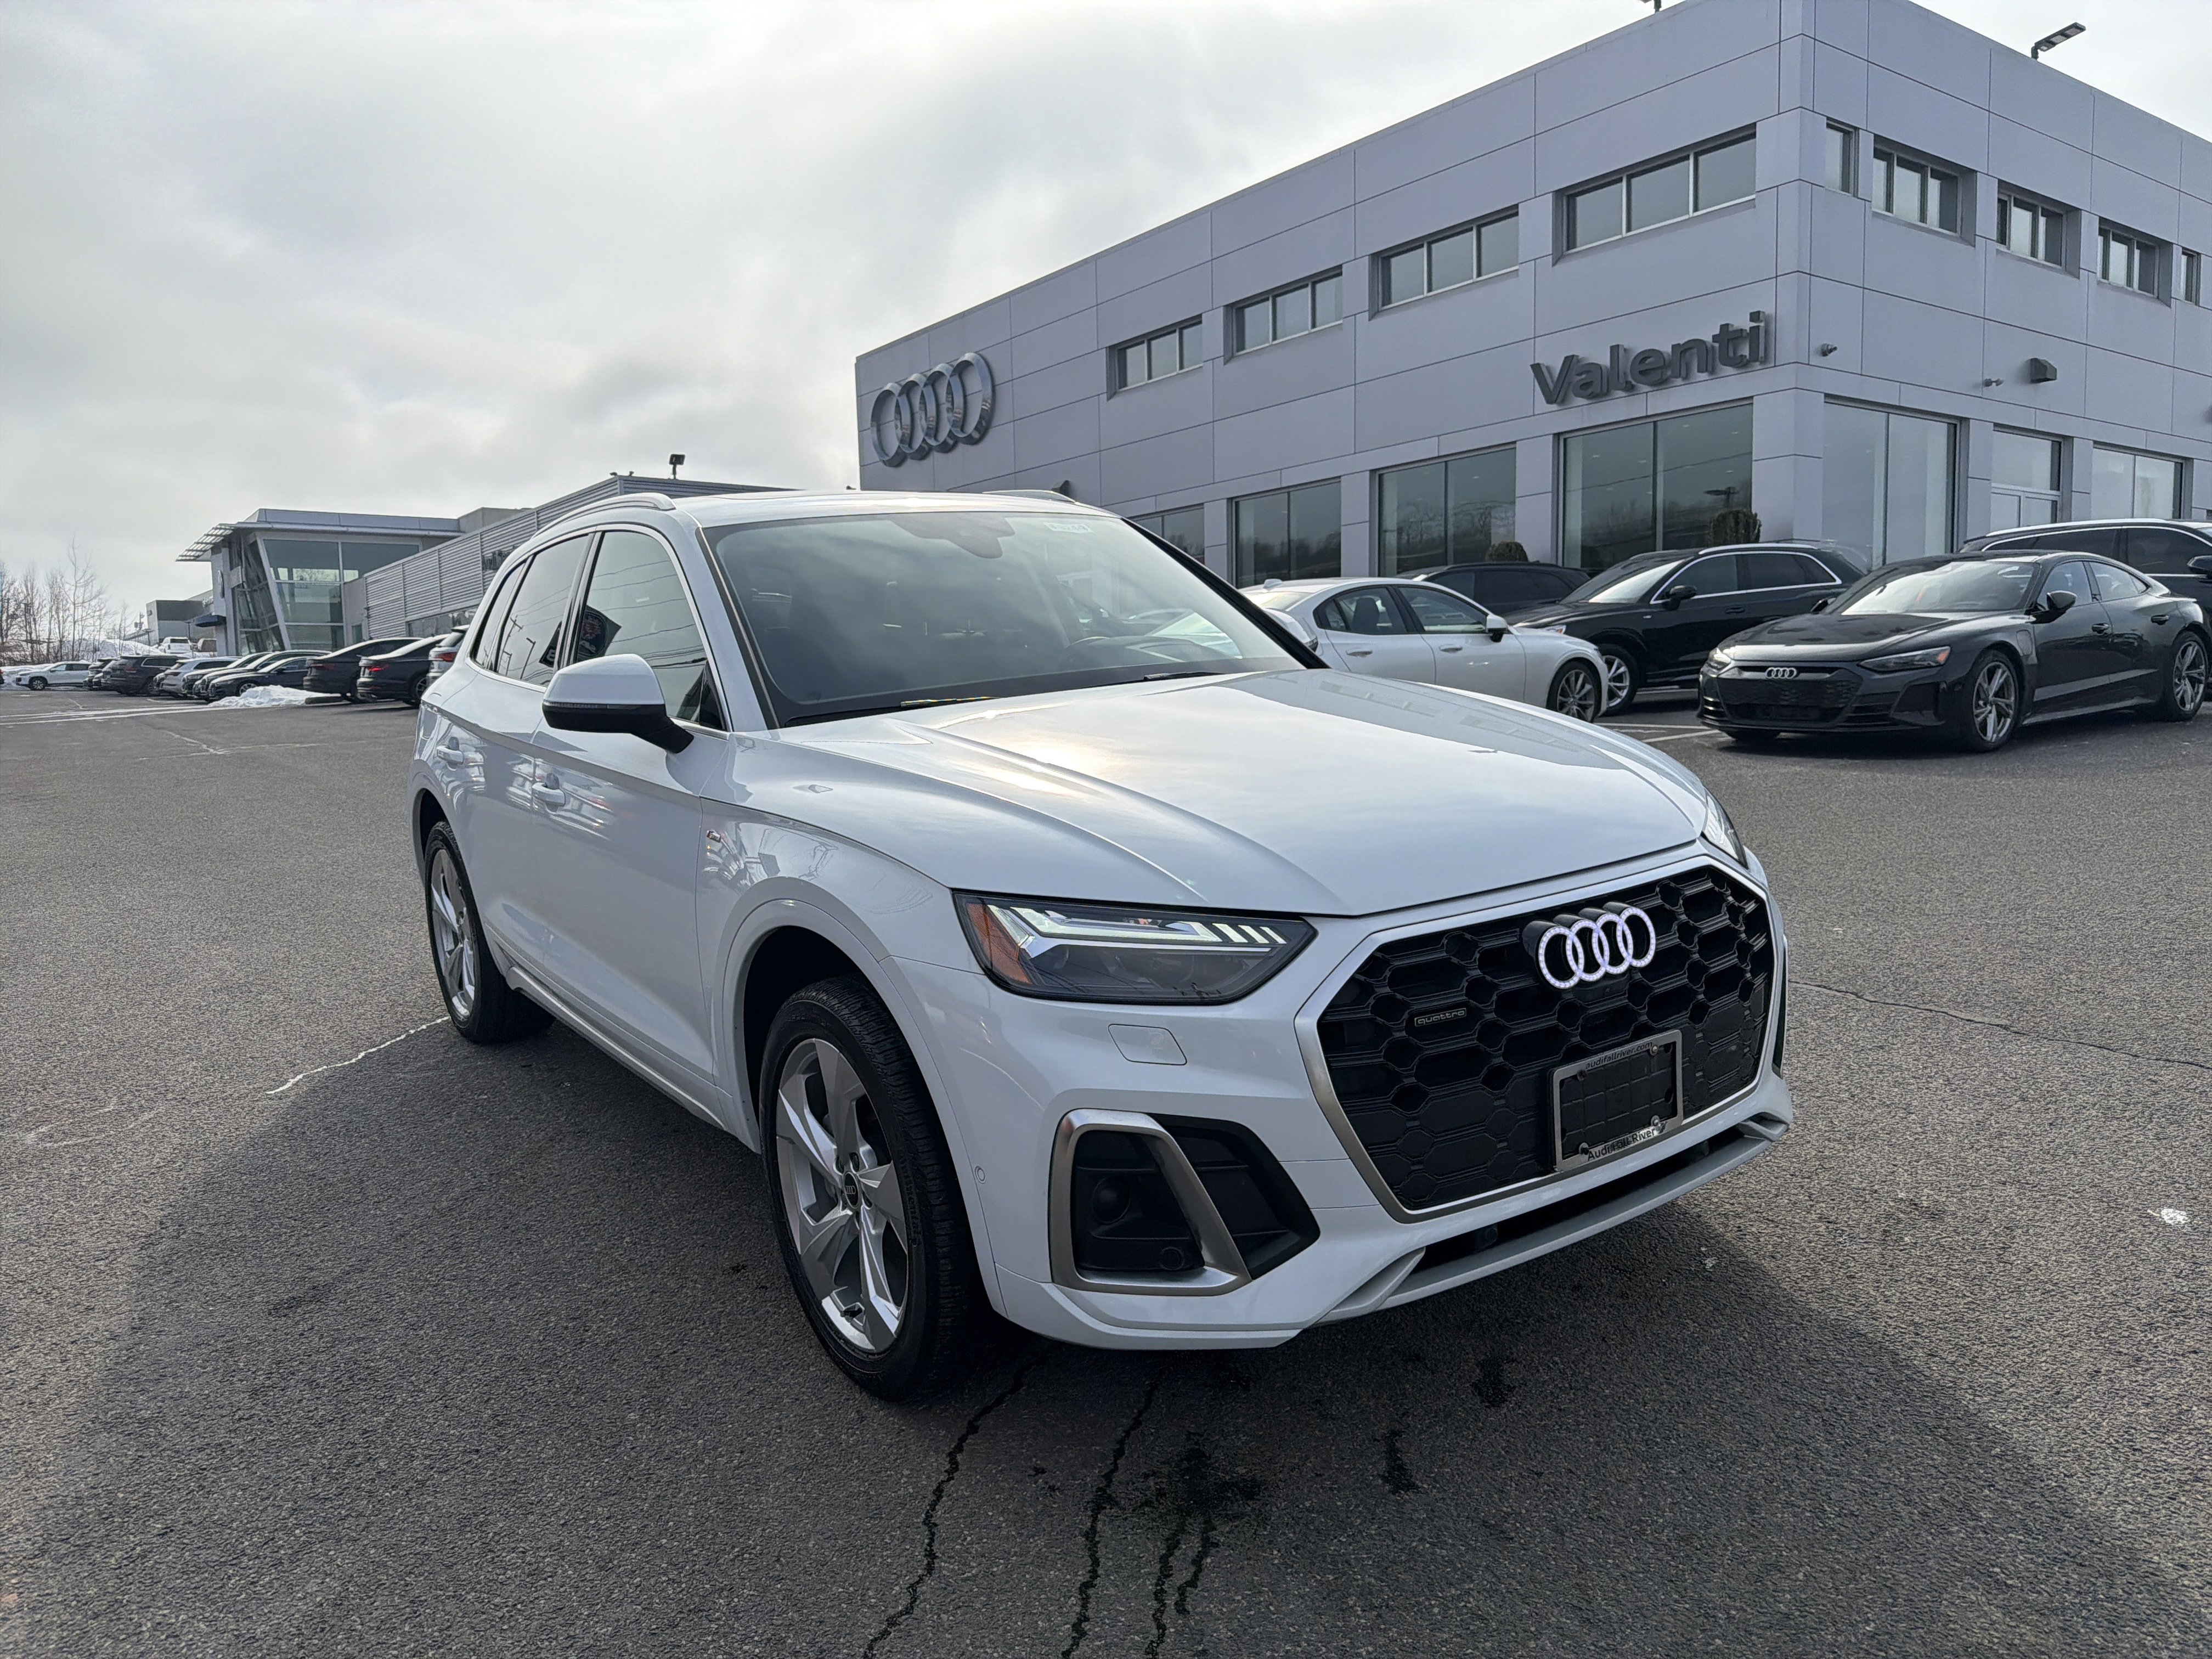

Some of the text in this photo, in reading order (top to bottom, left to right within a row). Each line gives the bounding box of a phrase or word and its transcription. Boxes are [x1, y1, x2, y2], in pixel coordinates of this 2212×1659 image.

[1530, 310, 1765, 404] Valenti
[1418, 1010, 1465, 1025] quattro
[1585, 1041, 1653, 1069] audifallriver.com
[1587, 1145, 1611, 1161] Audi
[1632, 1127, 1655, 1143] River
